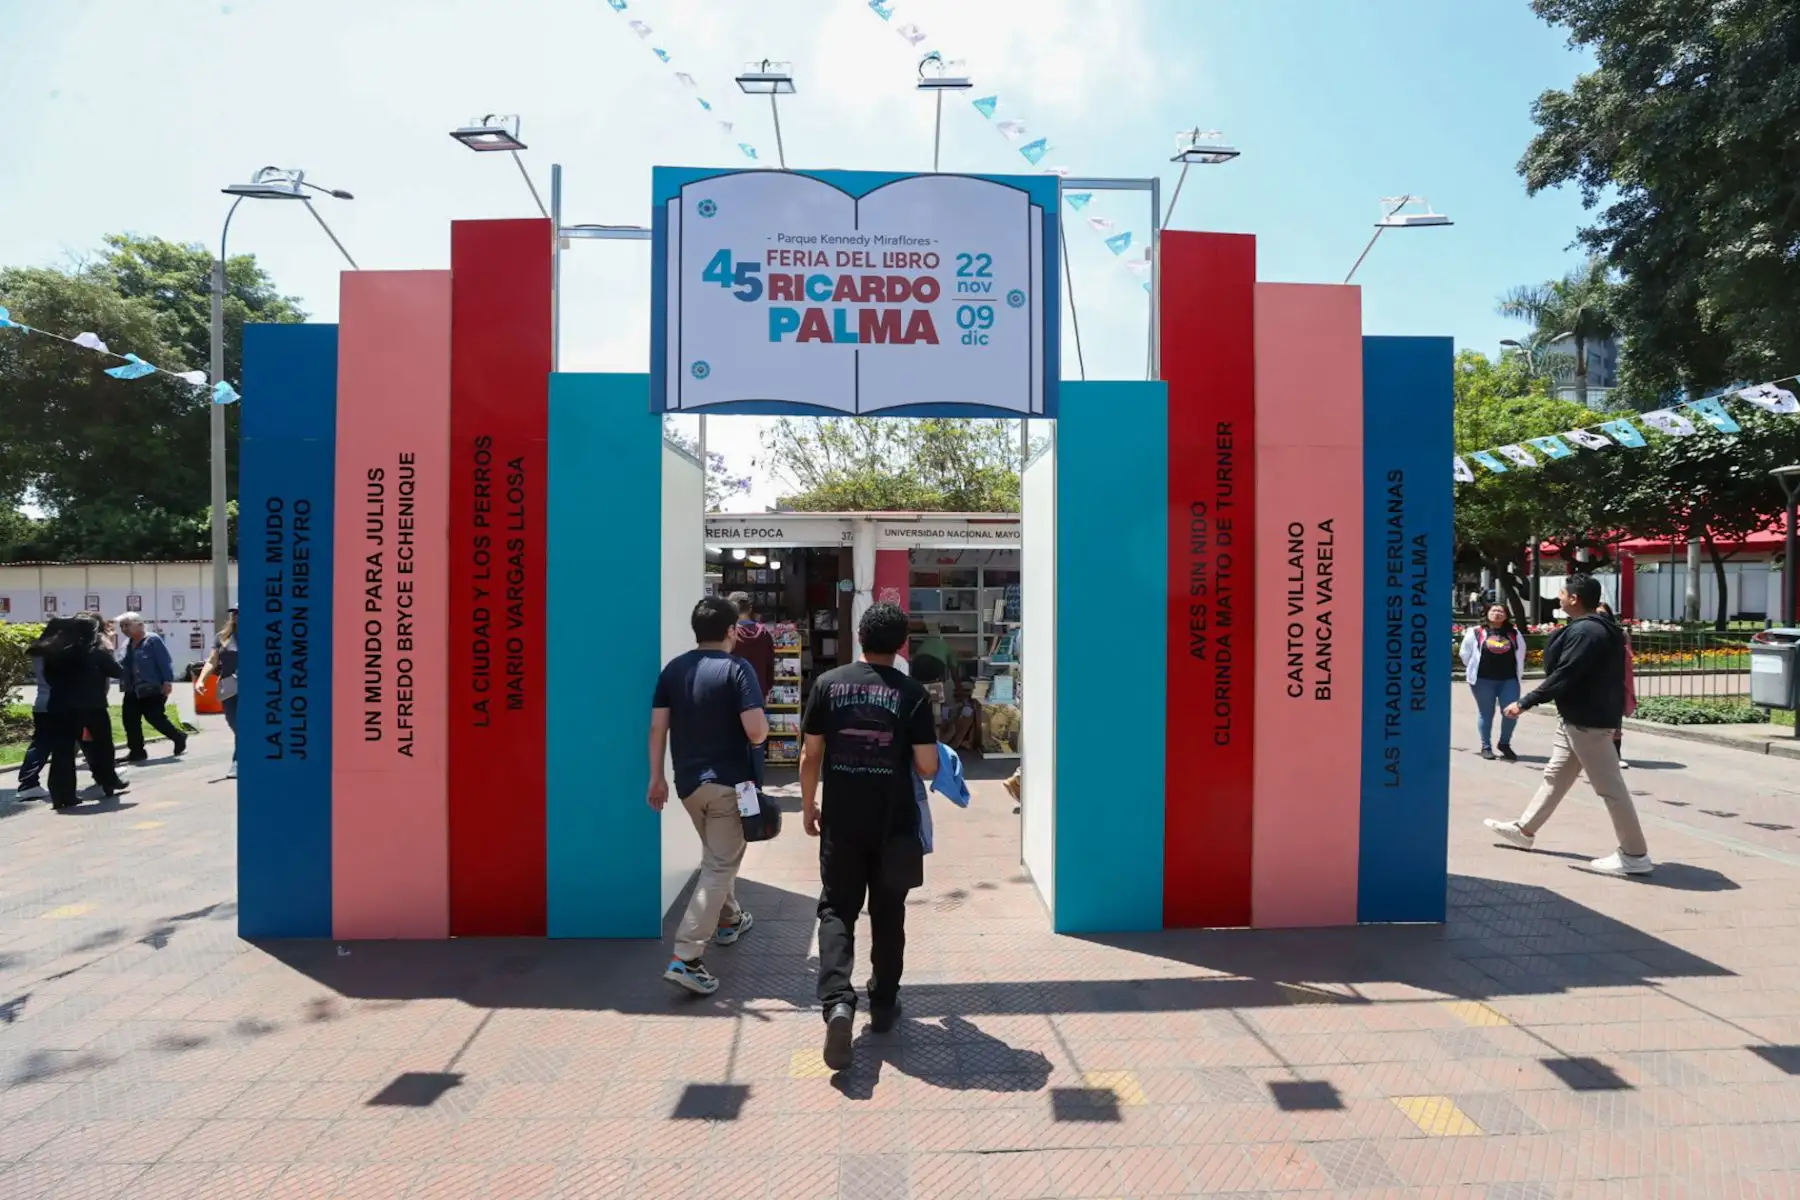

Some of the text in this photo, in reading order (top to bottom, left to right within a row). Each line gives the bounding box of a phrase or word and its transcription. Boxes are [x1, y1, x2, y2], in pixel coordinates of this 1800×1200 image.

[702, 249, 763, 302] 45
[767, 250, 940, 269] FERIA DEL LIBRO
[768, 273, 940, 303] RICARDO
[777, 233, 930, 246] Parque Kennedy Miraflores
[955, 253, 993, 277] 22
[956, 305, 994, 330] 09
[958, 279, 992, 293] nov
[769, 307, 939, 344] PALMA
[961, 331, 989, 346] dic
[365, 467, 384, 741] UN MUNDO PARA JULIUS
[398, 452, 415, 757] ALFREDO BRYCE ECHENIQUE
[473, 435, 492, 727] LA CIUDAD Y LOS PERROS
[506, 456, 524, 710] MARIO VARGAS LLOSA
[744, 527, 783, 538] ÉPOCA
[885, 529, 944, 537] UNIVERSIDAD
[1190, 501, 1208, 660] AVES SIN NIDO
[1214, 422, 1234, 747] CLORINDA MATTO DE TURNER
[1288, 522, 1304, 698] CANTO VILLANO
[1315, 518, 1334, 700] BLANCA VARELA
[266, 497, 283, 760] LA PALABRA DEL MUDO
[290, 500, 310, 759] JULIO RAMON RIBEYRO
[1385, 469, 1403, 788] LAS TRADICIONES PERUANAS
[1411, 532, 1428, 712] RICARDO PALMA
